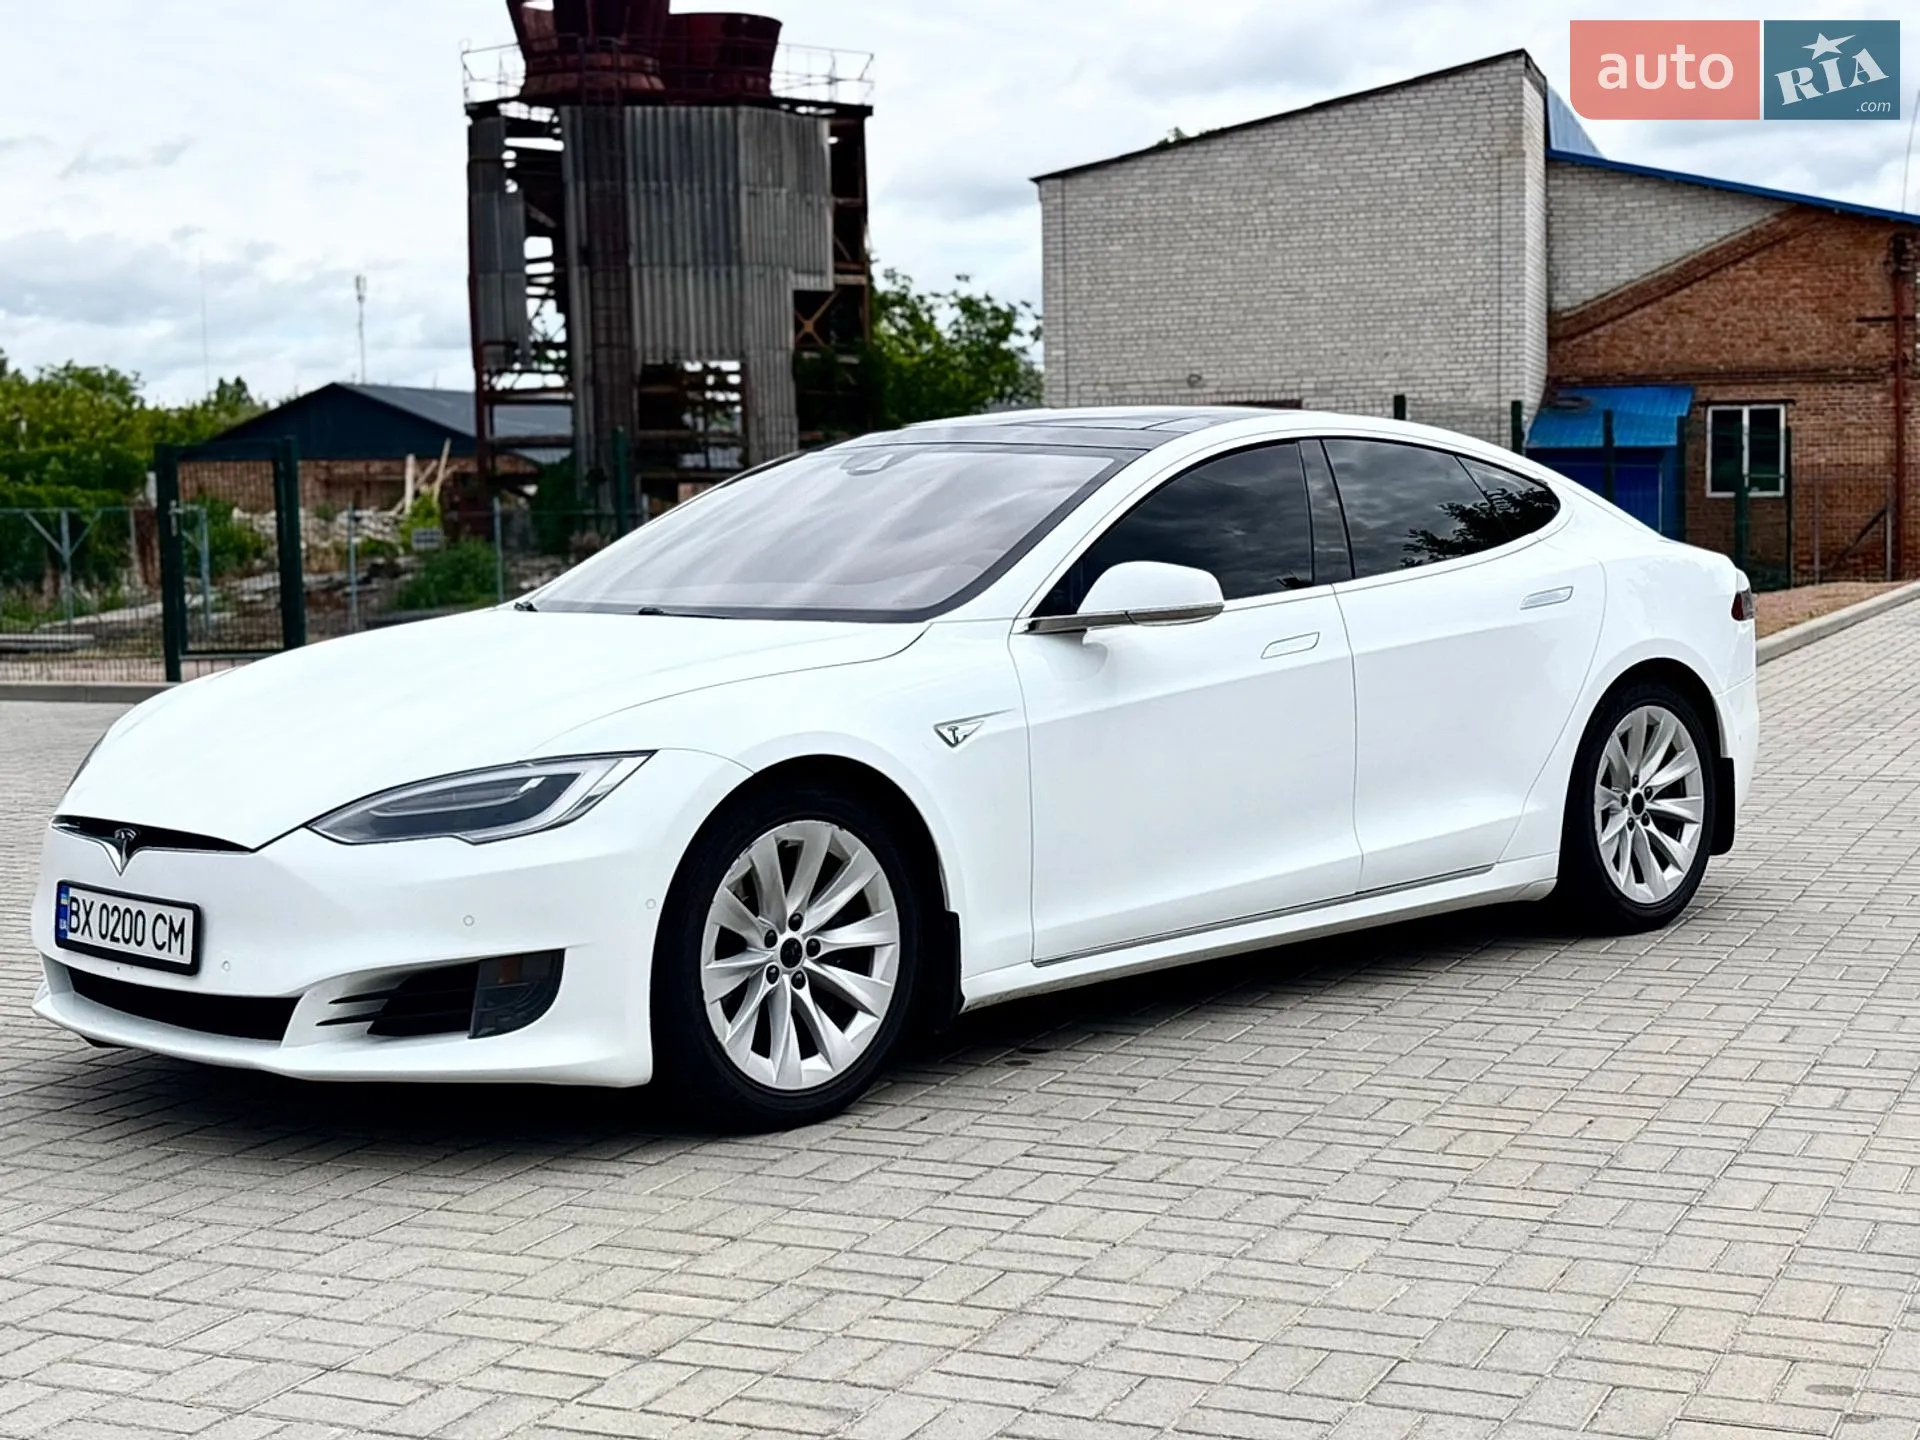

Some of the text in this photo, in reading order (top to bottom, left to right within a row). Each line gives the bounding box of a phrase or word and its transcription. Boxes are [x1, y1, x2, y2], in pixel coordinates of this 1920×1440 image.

[69, 896, 186, 955] BX 0200 CM
